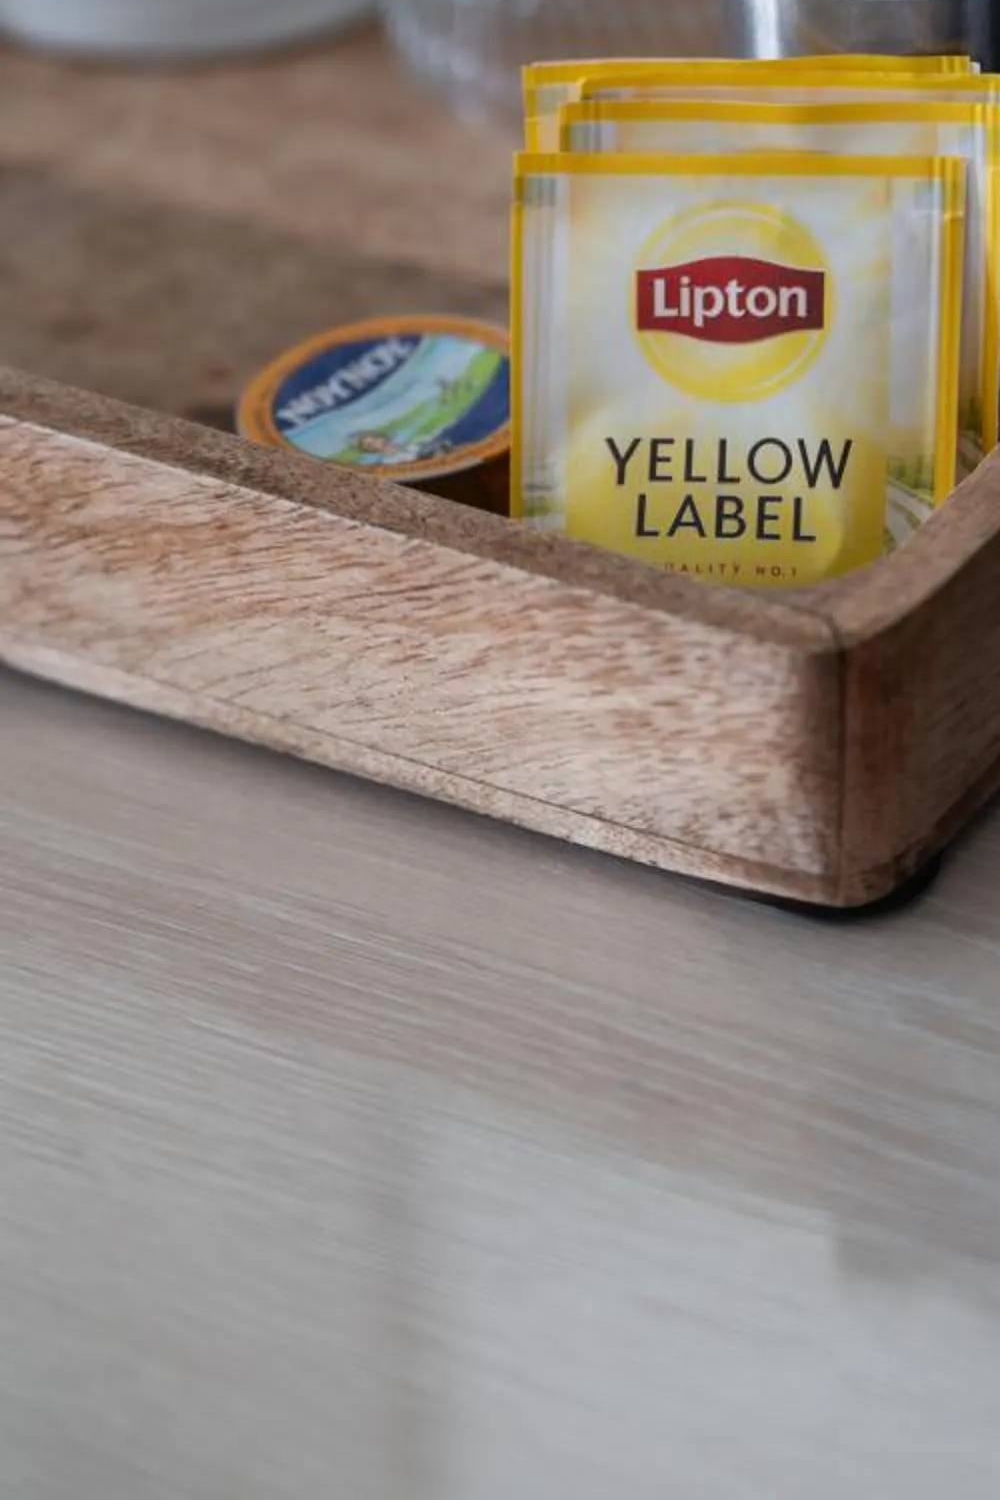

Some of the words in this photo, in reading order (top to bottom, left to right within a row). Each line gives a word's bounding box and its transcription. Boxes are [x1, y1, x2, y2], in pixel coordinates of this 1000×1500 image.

[654, 276, 808, 327] Lipton
[605, 437, 853, 489] YELLOW
[635, 494, 817, 542] LABEL
[661, 562, 742, 577] UALITY
